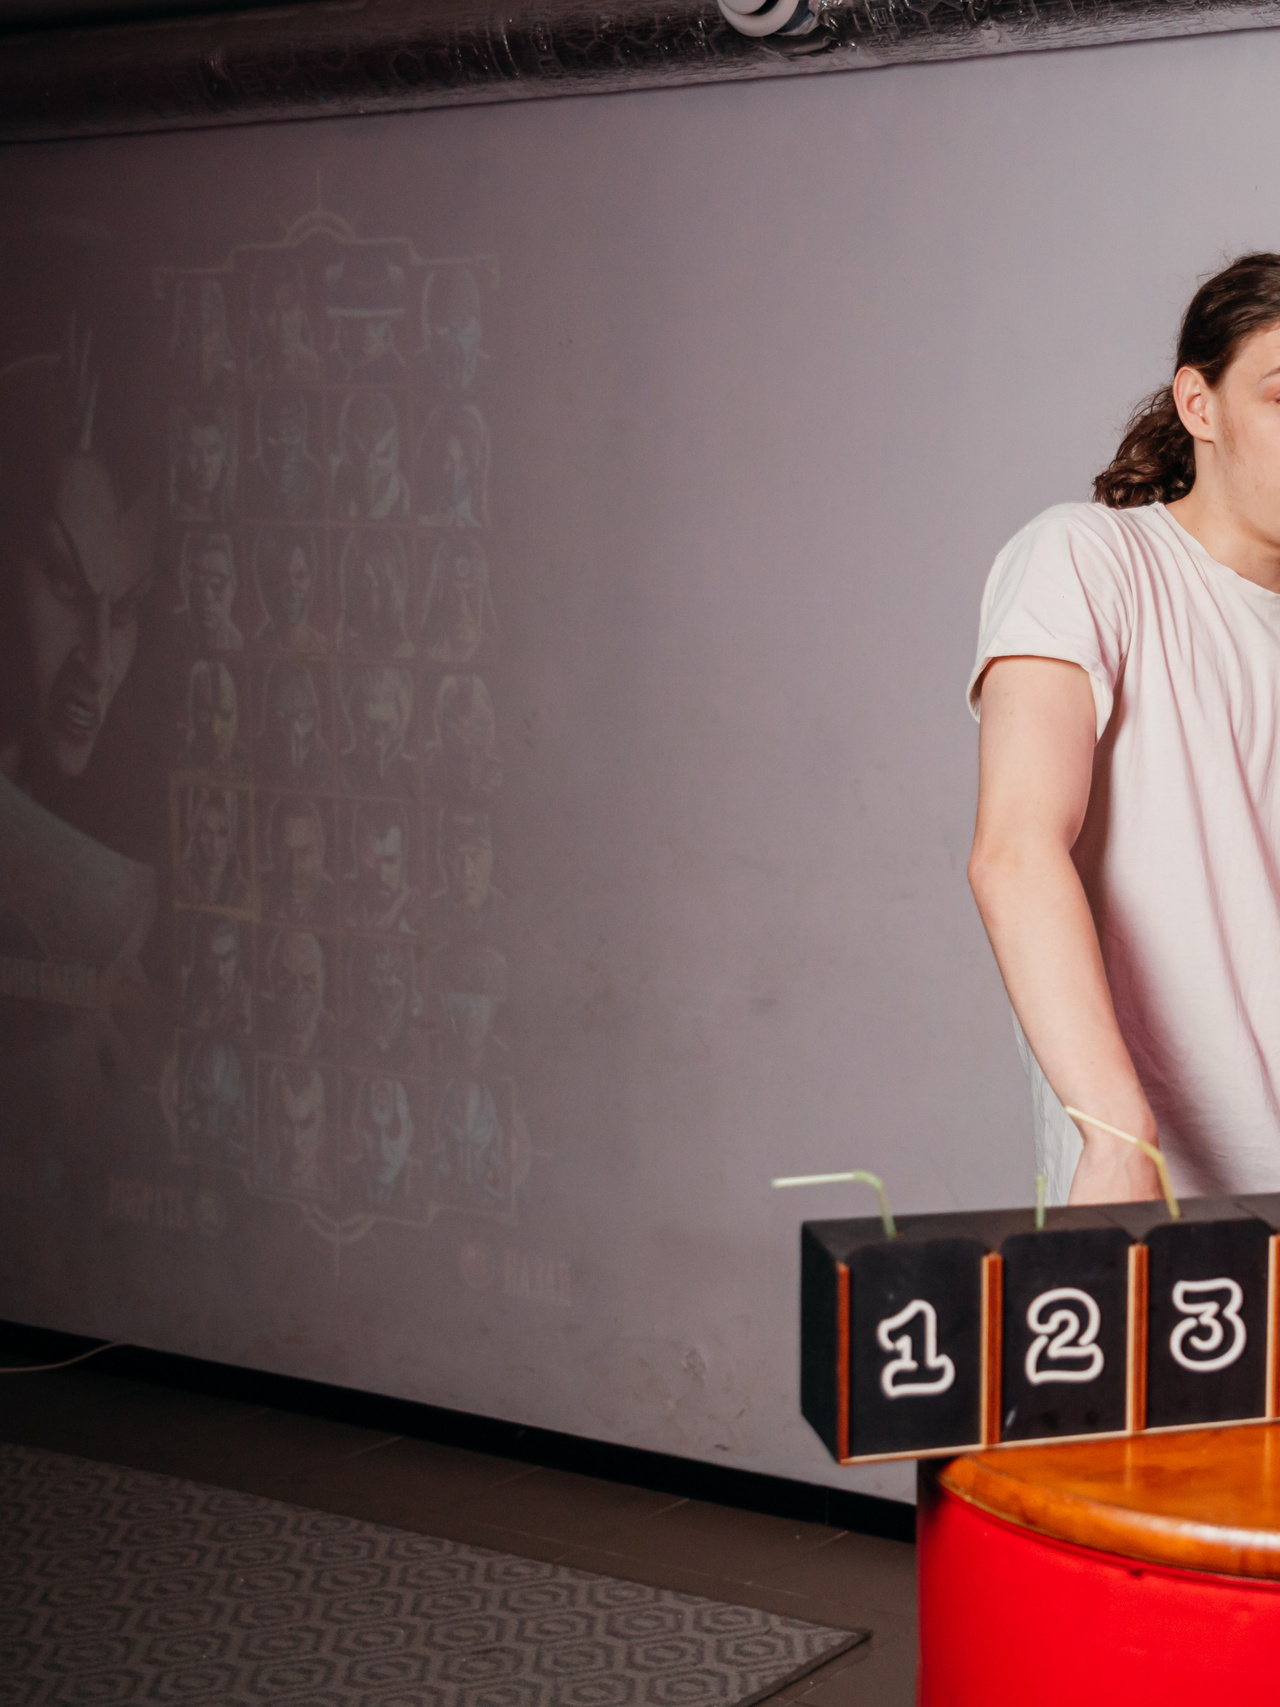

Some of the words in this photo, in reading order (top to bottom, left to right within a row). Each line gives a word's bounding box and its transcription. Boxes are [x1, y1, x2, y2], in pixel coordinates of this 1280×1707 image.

[877, 1299, 956, 1398] 1
[1025, 1287, 1105, 1386] 2
[1169, 1277, 1248, 1373] 3
